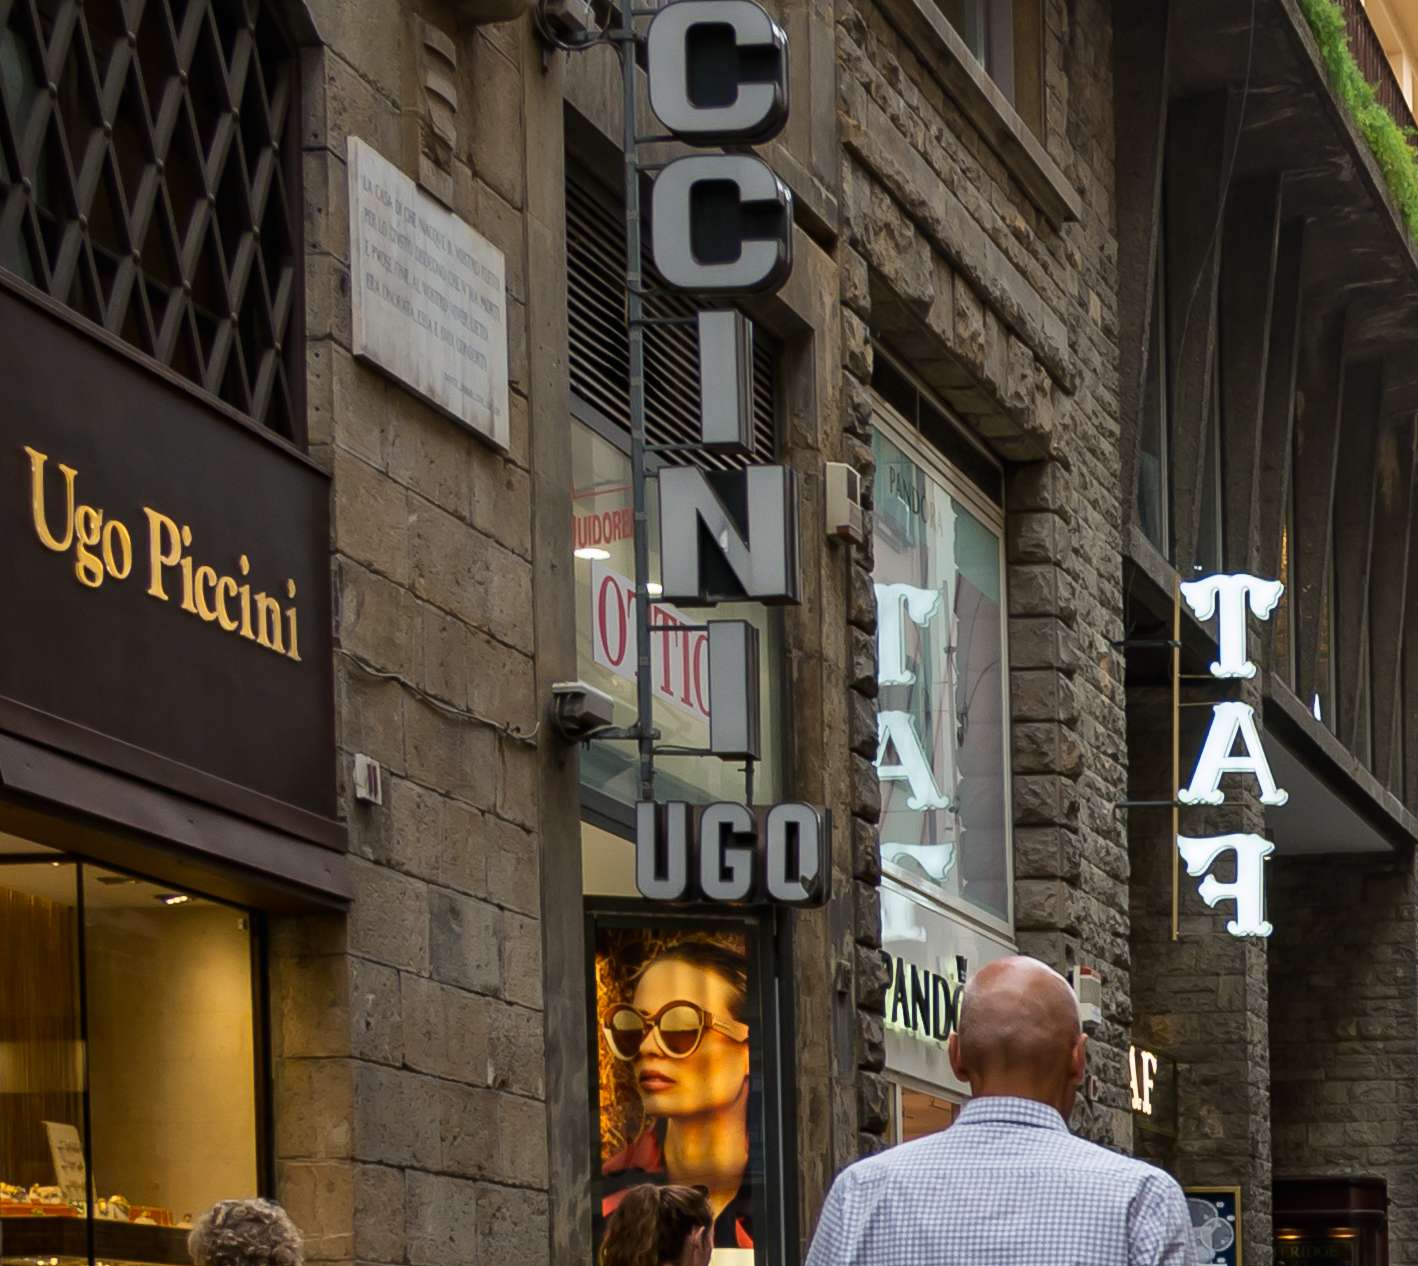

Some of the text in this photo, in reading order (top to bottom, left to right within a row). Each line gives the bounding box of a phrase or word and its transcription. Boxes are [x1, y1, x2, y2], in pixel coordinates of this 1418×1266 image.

[24, 446, 301, 661] Ugo Piccini
[636, 801, 830, 903] UGO
